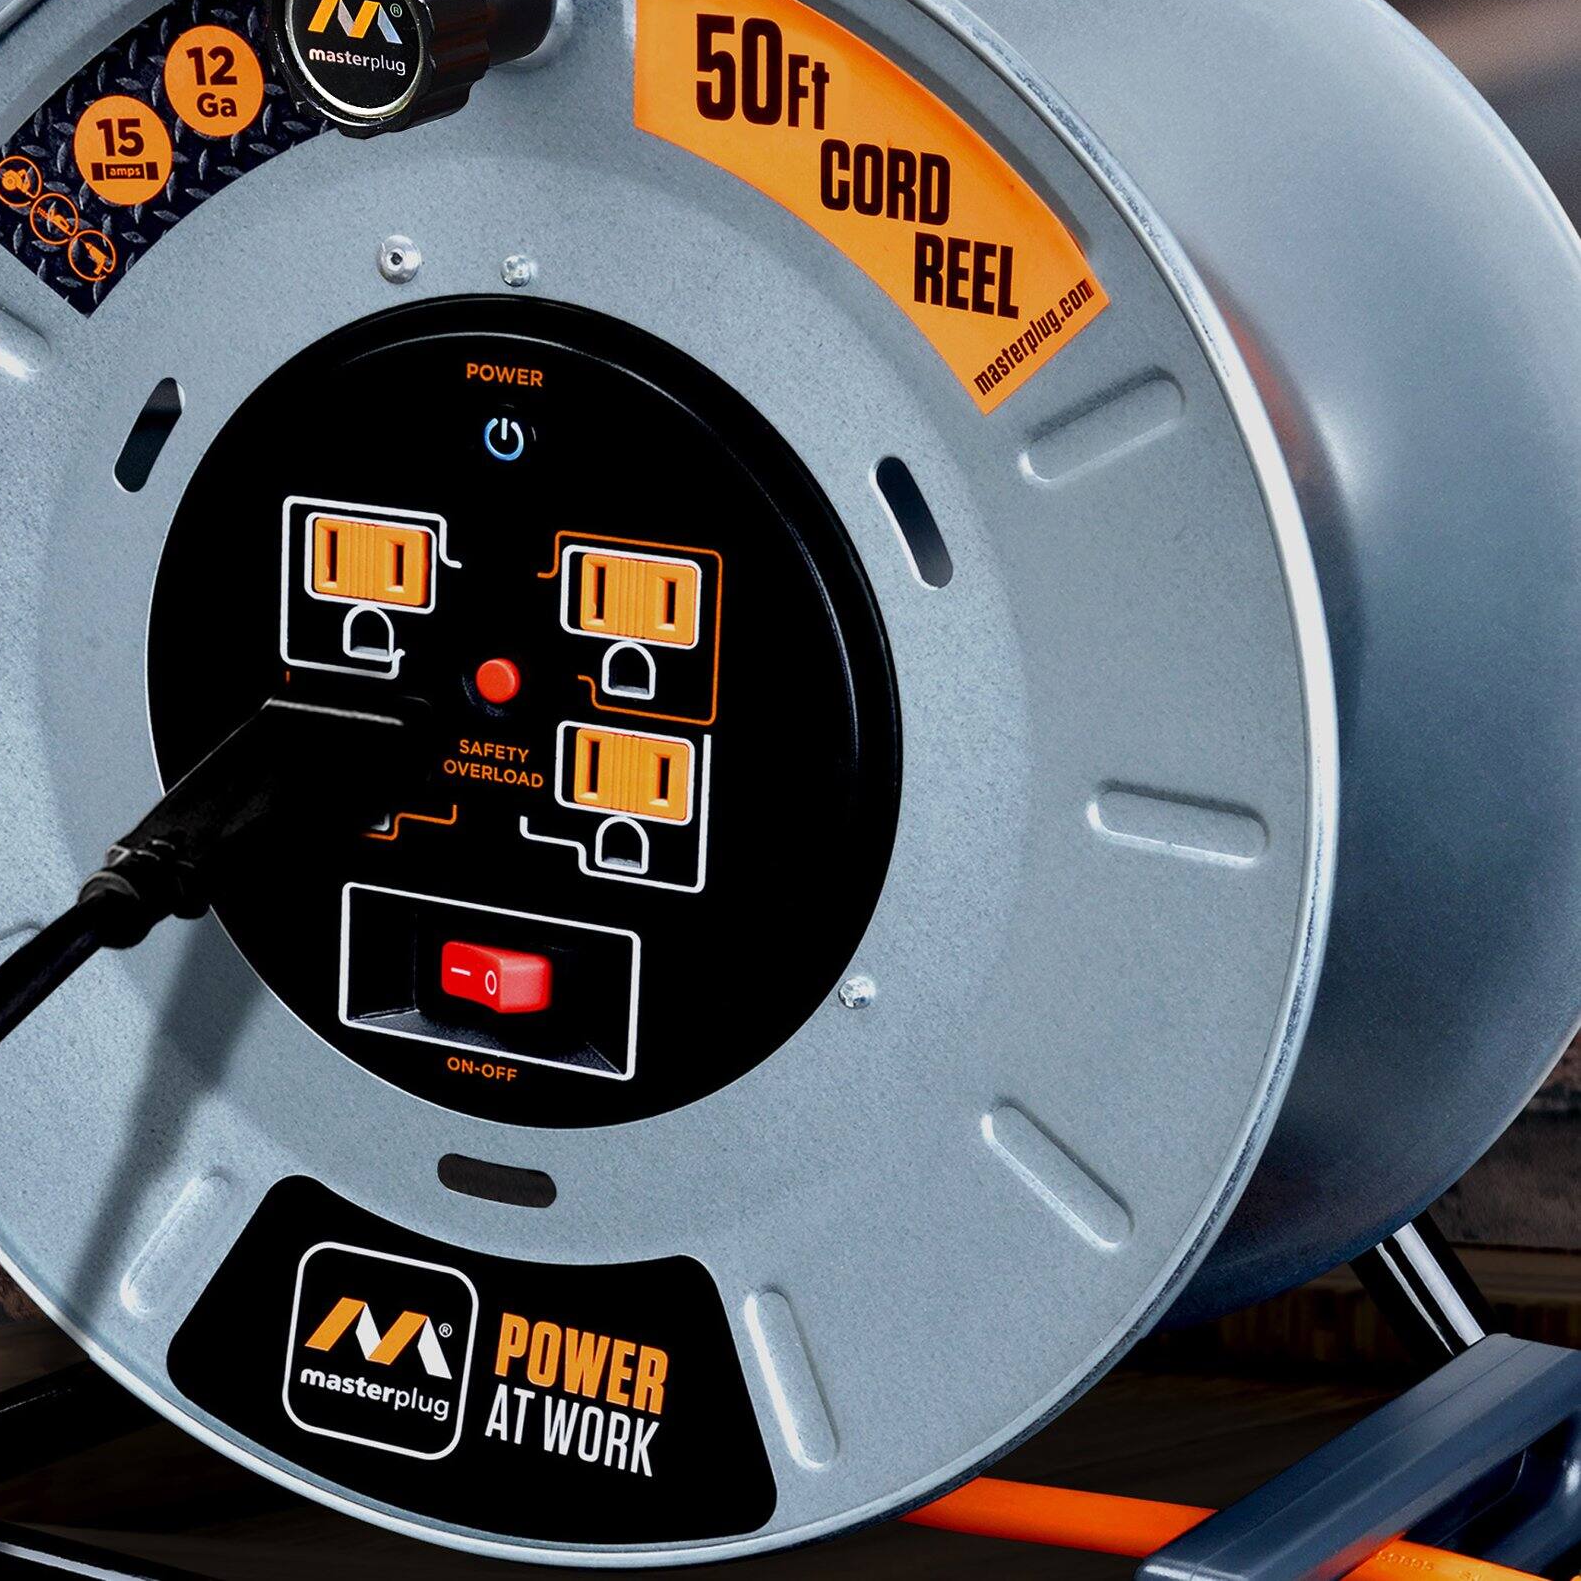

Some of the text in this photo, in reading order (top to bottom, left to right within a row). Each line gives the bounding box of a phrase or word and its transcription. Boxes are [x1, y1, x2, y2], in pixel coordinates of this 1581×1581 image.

[184, 45, 238, 87] 12
[308, 47, 406, 77] masterplug
[695, 13, 830, 130] 50Ft
[195, 92, 238, 119] Ga
[95, 118, 145, 157] 15
[109, 167, 141, 178] amps
[820, 138, 951, 226] CORD
[914, 231, 1019, 320] REEL
[973, 278, 1095, 396] masterplug.com
[466, 362, 544, 388] POWER
[459, 739, 530, 763] SAFETY
[443, 759, 544, 788] OVERLOAD
[447, 1057, 518, 1082] ON-OFF
[493, 1311, 670, 1416] POWER
[300, 1365, 451, 1422] masterplug
[484, 1383, 660, 1478] AT WORK
